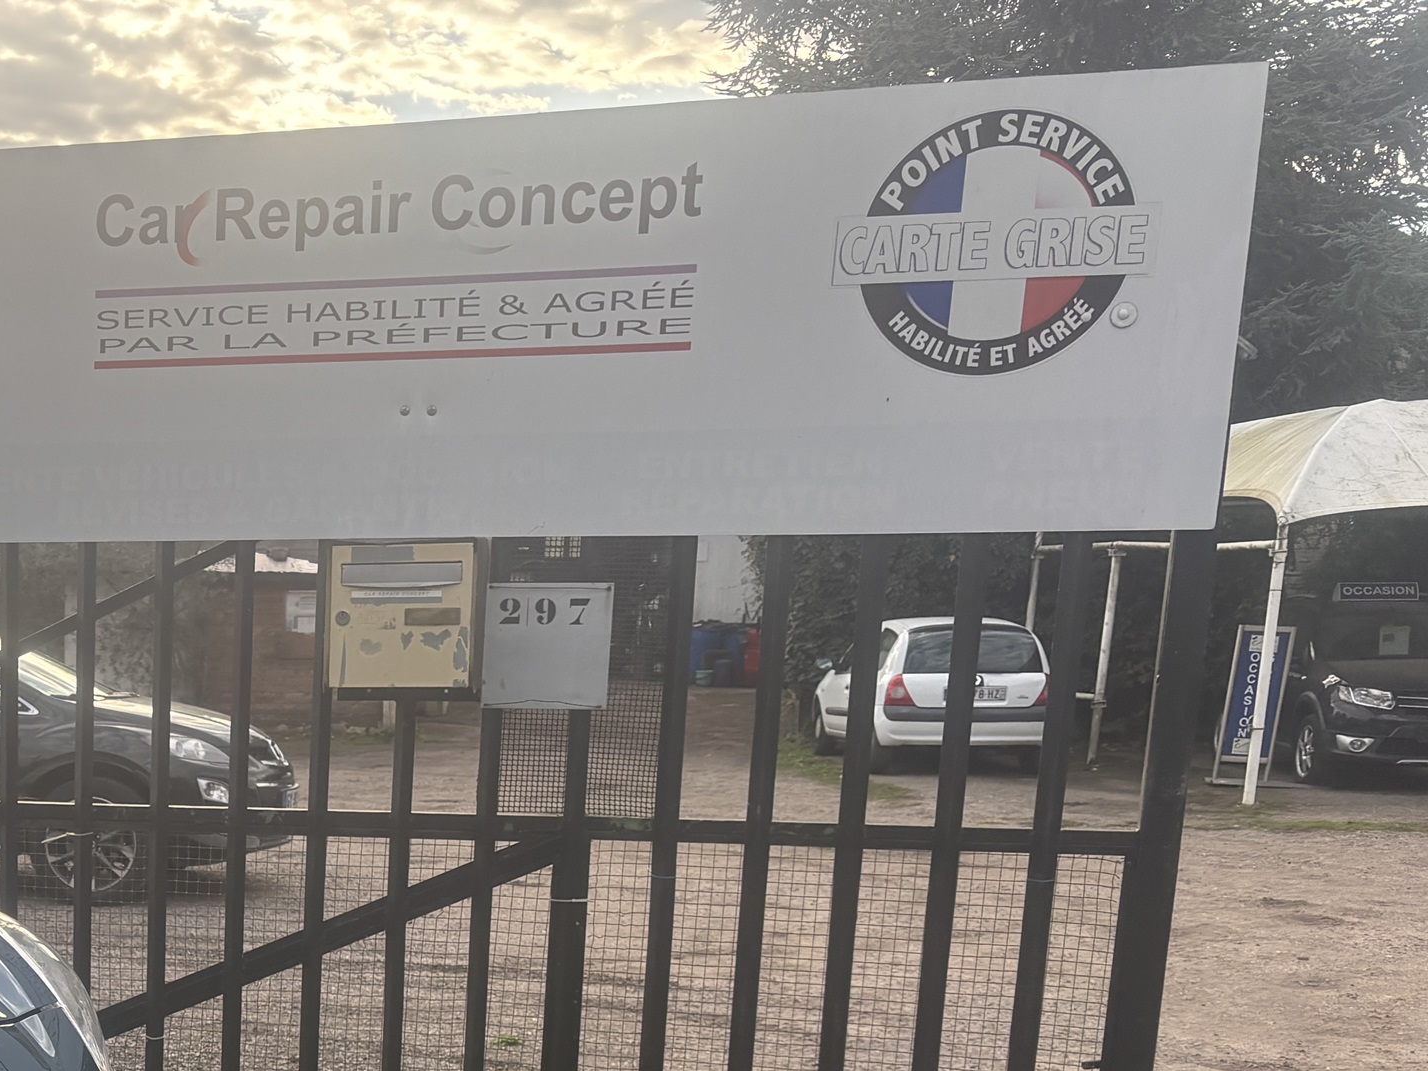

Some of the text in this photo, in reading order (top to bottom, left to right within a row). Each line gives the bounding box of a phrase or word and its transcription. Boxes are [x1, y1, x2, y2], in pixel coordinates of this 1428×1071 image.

[880, 112, 1126, 212] POINT SERVICE
[95, 161, 705, 252] Car Repair Concept
[838, 213, 1151, 276] CARTE GRISE
[95, 279, 694, 331] SERVICE HABILITÉ & AGRÉÉ
[98, 317, 692, 355] PAR LA PRÉFECTURE
[887, 296, 1095, 368] HABILITÉ ET AGRÉÉ
[498, 597, 591, 626] 297
[1342, 586, 1416, 596] OCCASION
[1237, 652, 1260, 738] OCCASION
